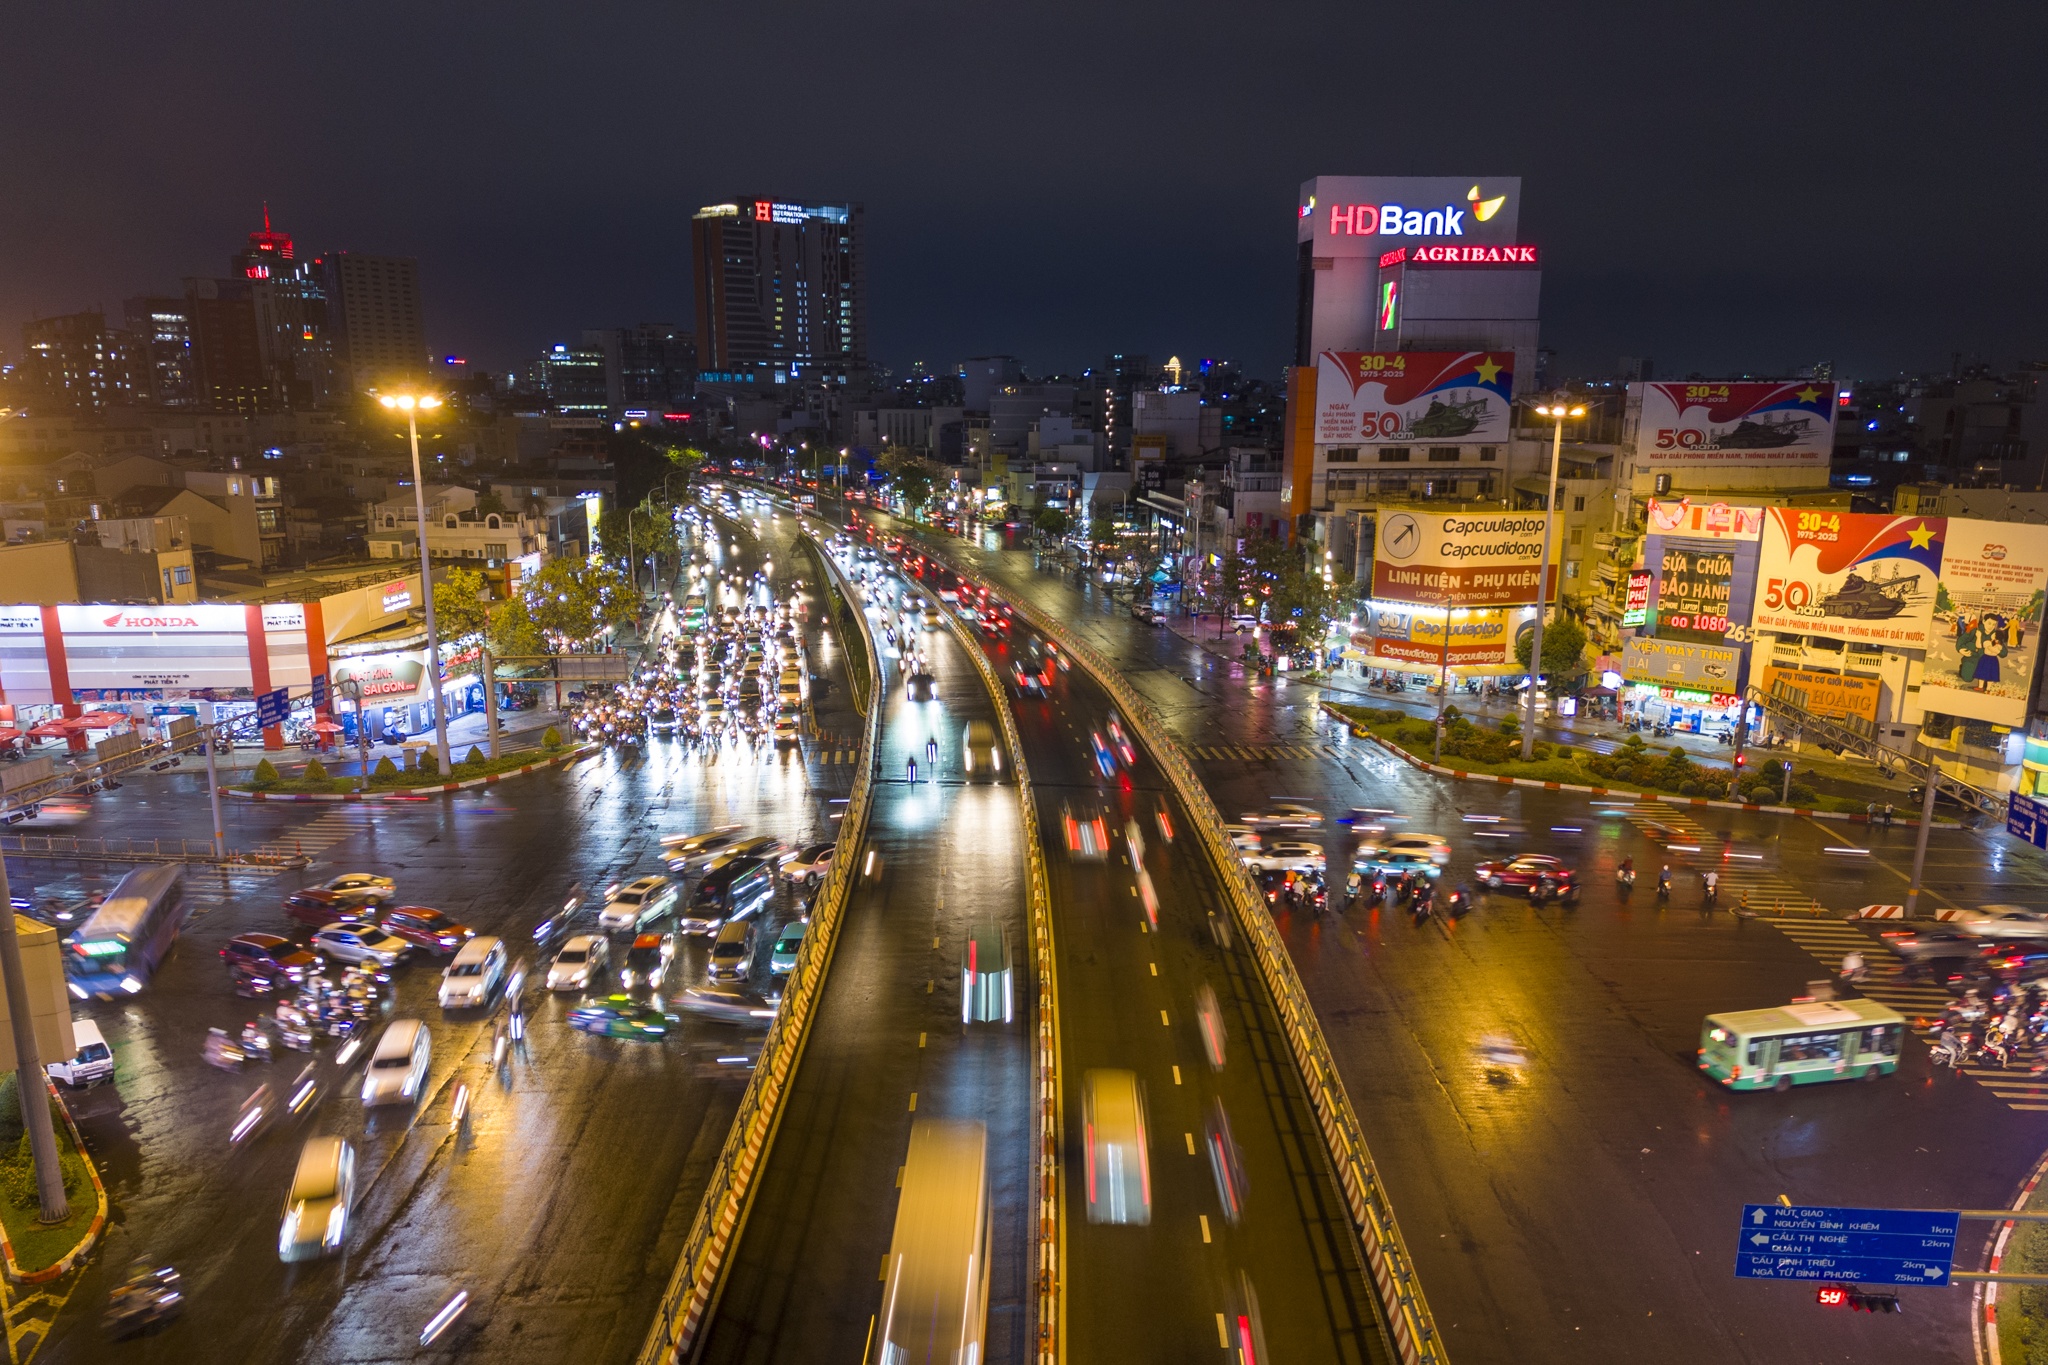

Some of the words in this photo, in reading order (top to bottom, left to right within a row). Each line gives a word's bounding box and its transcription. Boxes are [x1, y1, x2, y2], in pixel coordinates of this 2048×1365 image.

[1330, 204, 1464, 236] HDBank
[1412, 246, 1536, 262] AGRIBANK
[1360, 356, 1406, 370] 30-4
[1686, 386, 1730, 398] 30-4
[1361, 411, 1400, 438] 50
[1655, 428, 1702, 448] 50
[1443, 517, 1545, 536] Capcuulaptop
[1647, 498, 1764, 537] VIỆN
[1798, 513, 1840, 532] 30-4
[1797, 531, 1838, 541] 1975-2025
[1440, 542, 1542, 560] Capcuudidong
[1662, 551, 1687, 572] SỬA
[1697, 554, 1732, 576] CHỮA
[1389, 570, 1420, 585] LINH
[1424, 572, 1460, 590] KIỆN
[1474, 574, 1504, 590] PHỤ
[1507, 570, 1541, 589] KIỆN
[1659, 572, 1688, 596] BẢO
[1693, 579, 1730, 600] HÀNH
[1416, 591, 1442, 599] LAPTOP
[1468, 592, 1489, 601] THOẠI
[1764, 578, 1809, 611] 50
[1795, 604, 1825, 617] năm
[125, 618, 198, 627] HONDA
[1692, 614, 1727, 632] 1080
[1758, 614, 1773, 625] NGÀY
[1788, 618, 1809, 630] PHÓNG
[1811, 620, 1827, 632] MIỀN
[1848, 624, 1869, 636] THỐNG
[1871, 626, 1889, 638] NHẤT
[1906, 631, 1925, 642] NƯỚC
[1725, 622, 1755, 643] 265
[1381, 644, 1438, 662] Capcuudidong
[1446, 651, 1504, 663] Capcuulaptop
[1665, 644, 1696, 657] MÁY
[1699, 647, 1733, 662] TÍNH
[1778, 671, 1792, 681] PHỤ
[1794, 672, 1812, 683] TÙNG
[1815, 676, 1825, 684] CƠ
[364, 683, 380, 696] SÀI
[382, 679, 404, 692] GÒN
[1674, 690, 1710, 703] LAPTOP
[1712, 694, 1739, 707] CAO
[1849, 1222, 1880, 1230] KHIÊM
[1799, 1234, 1814, 1243] THỊ
